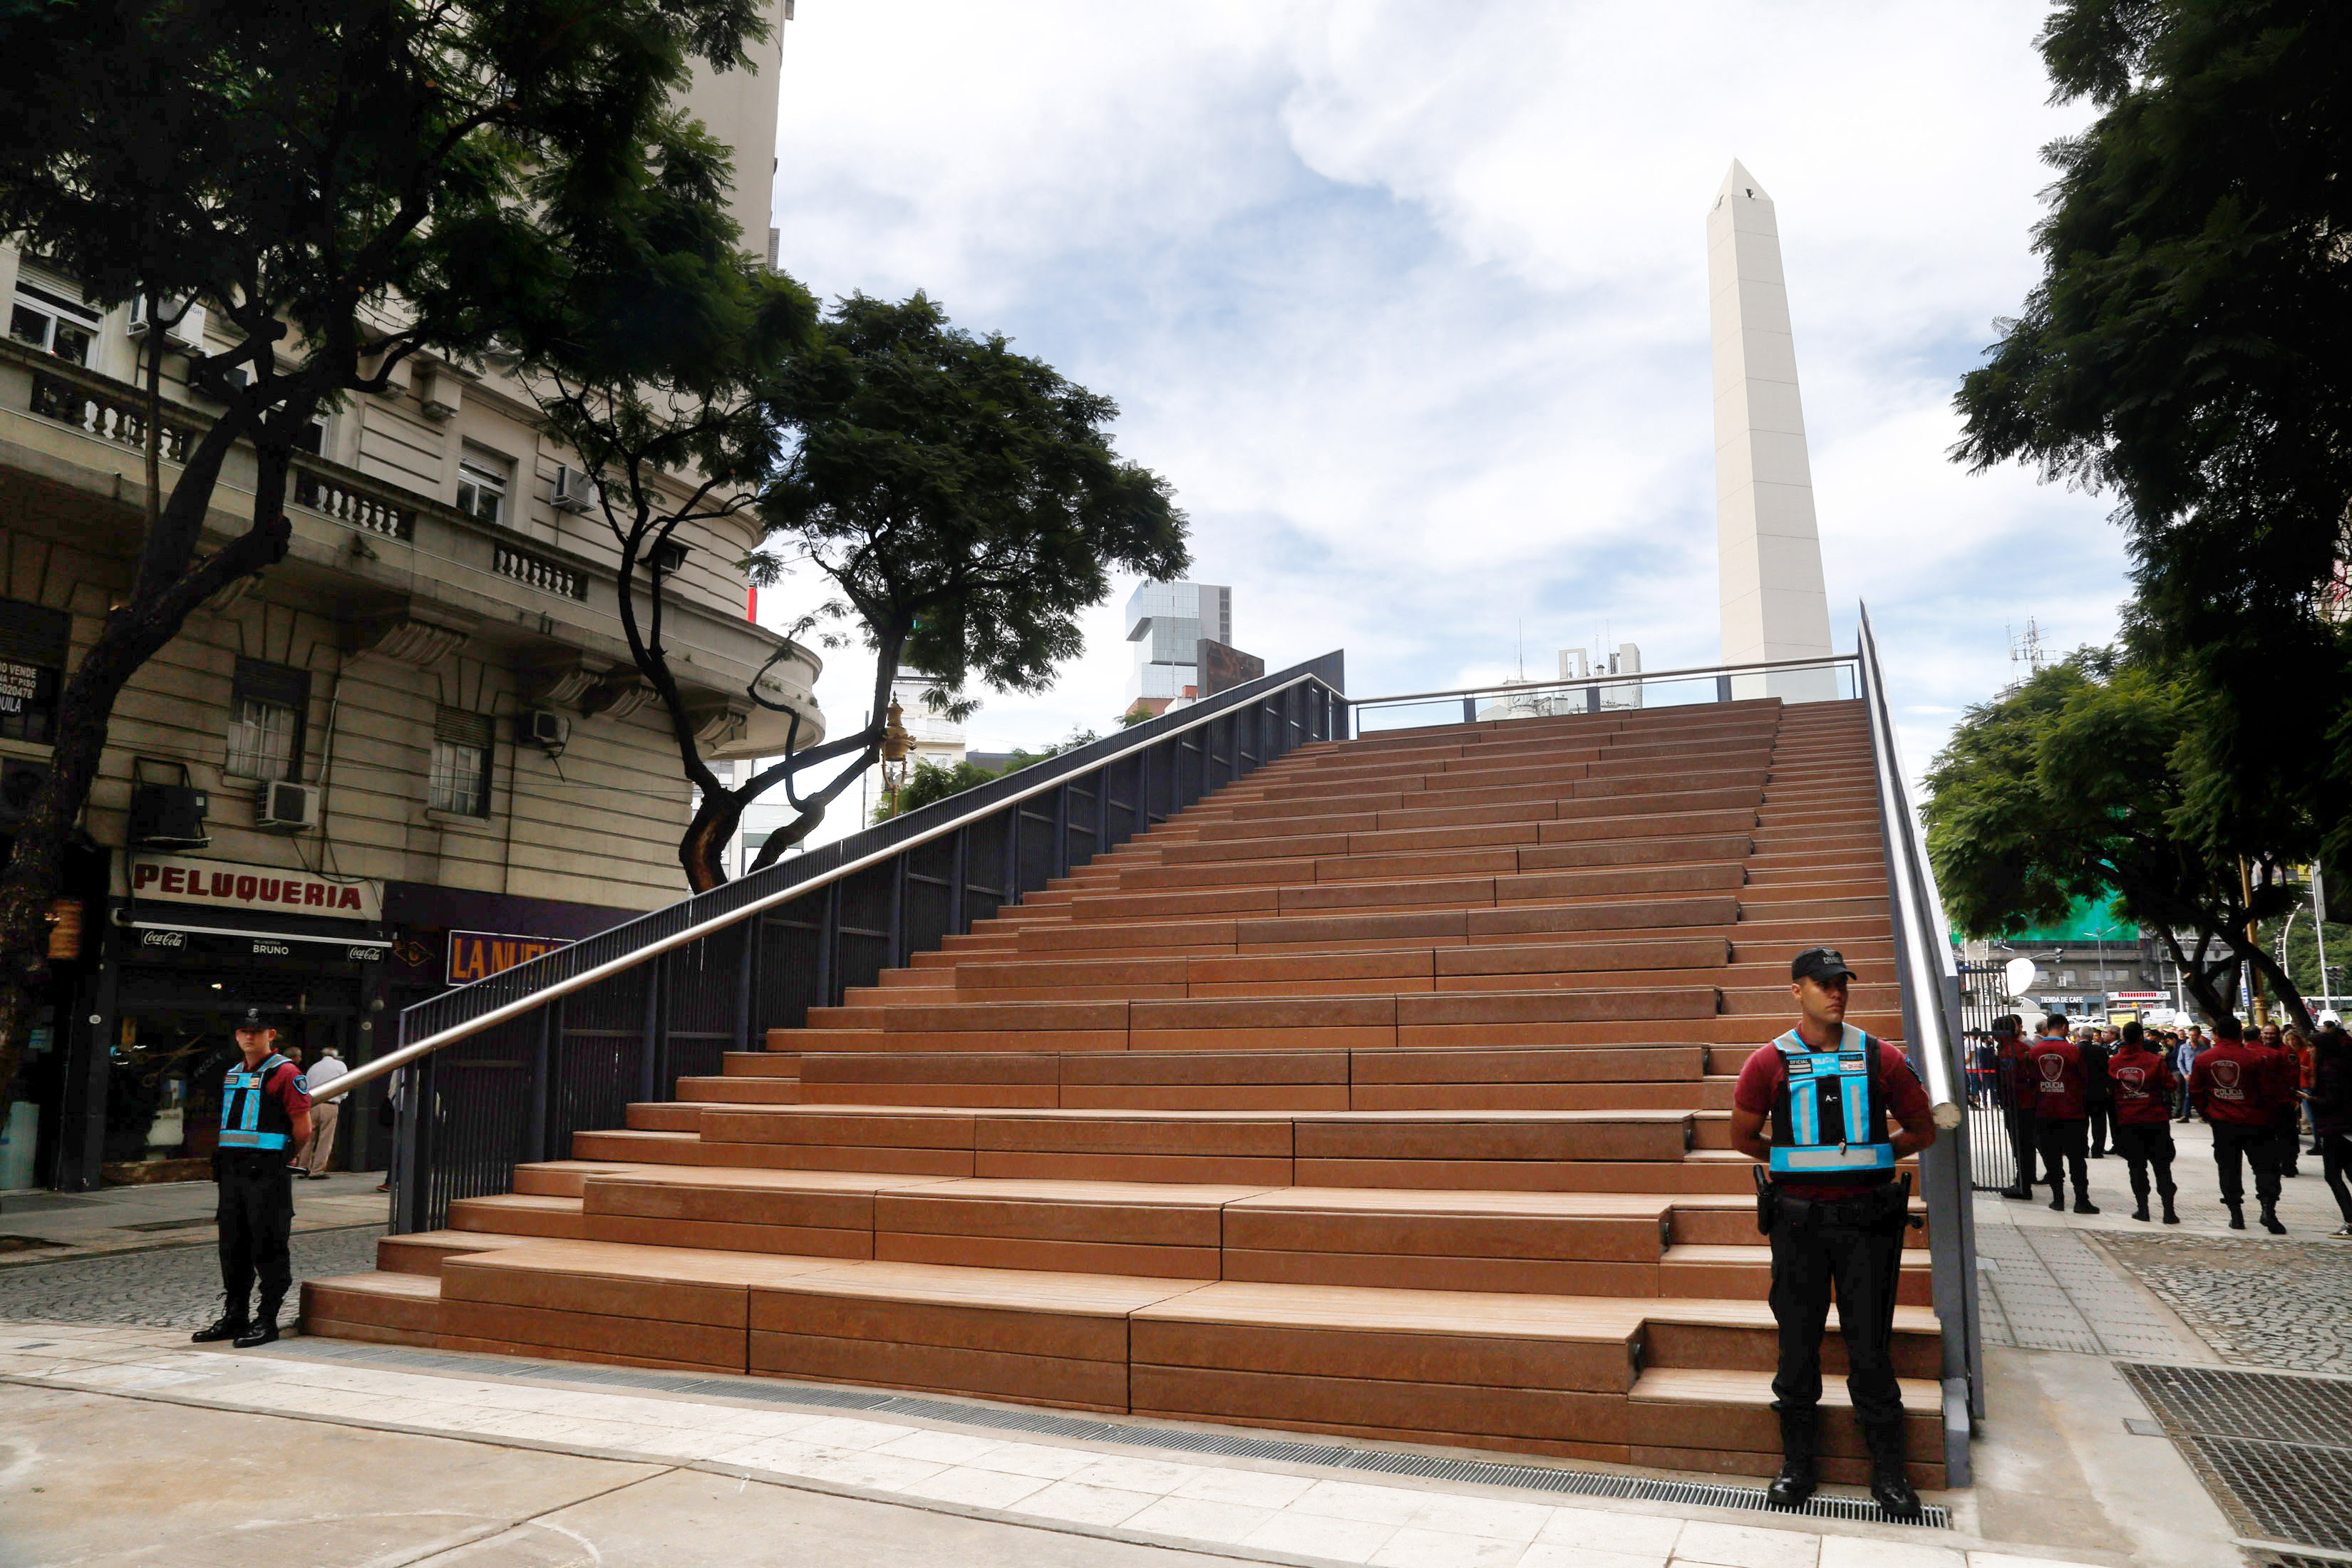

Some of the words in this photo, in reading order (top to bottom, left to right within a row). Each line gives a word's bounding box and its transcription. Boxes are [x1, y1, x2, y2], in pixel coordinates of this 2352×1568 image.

[10, 664, 37, 679] VENDE
[19, 678, 36, 688] PISO
[133, 863, 362, 910] PELUQUERIA
[252, 944, 289, 956] BRUNO
[453, 938, 486, 979] LA
